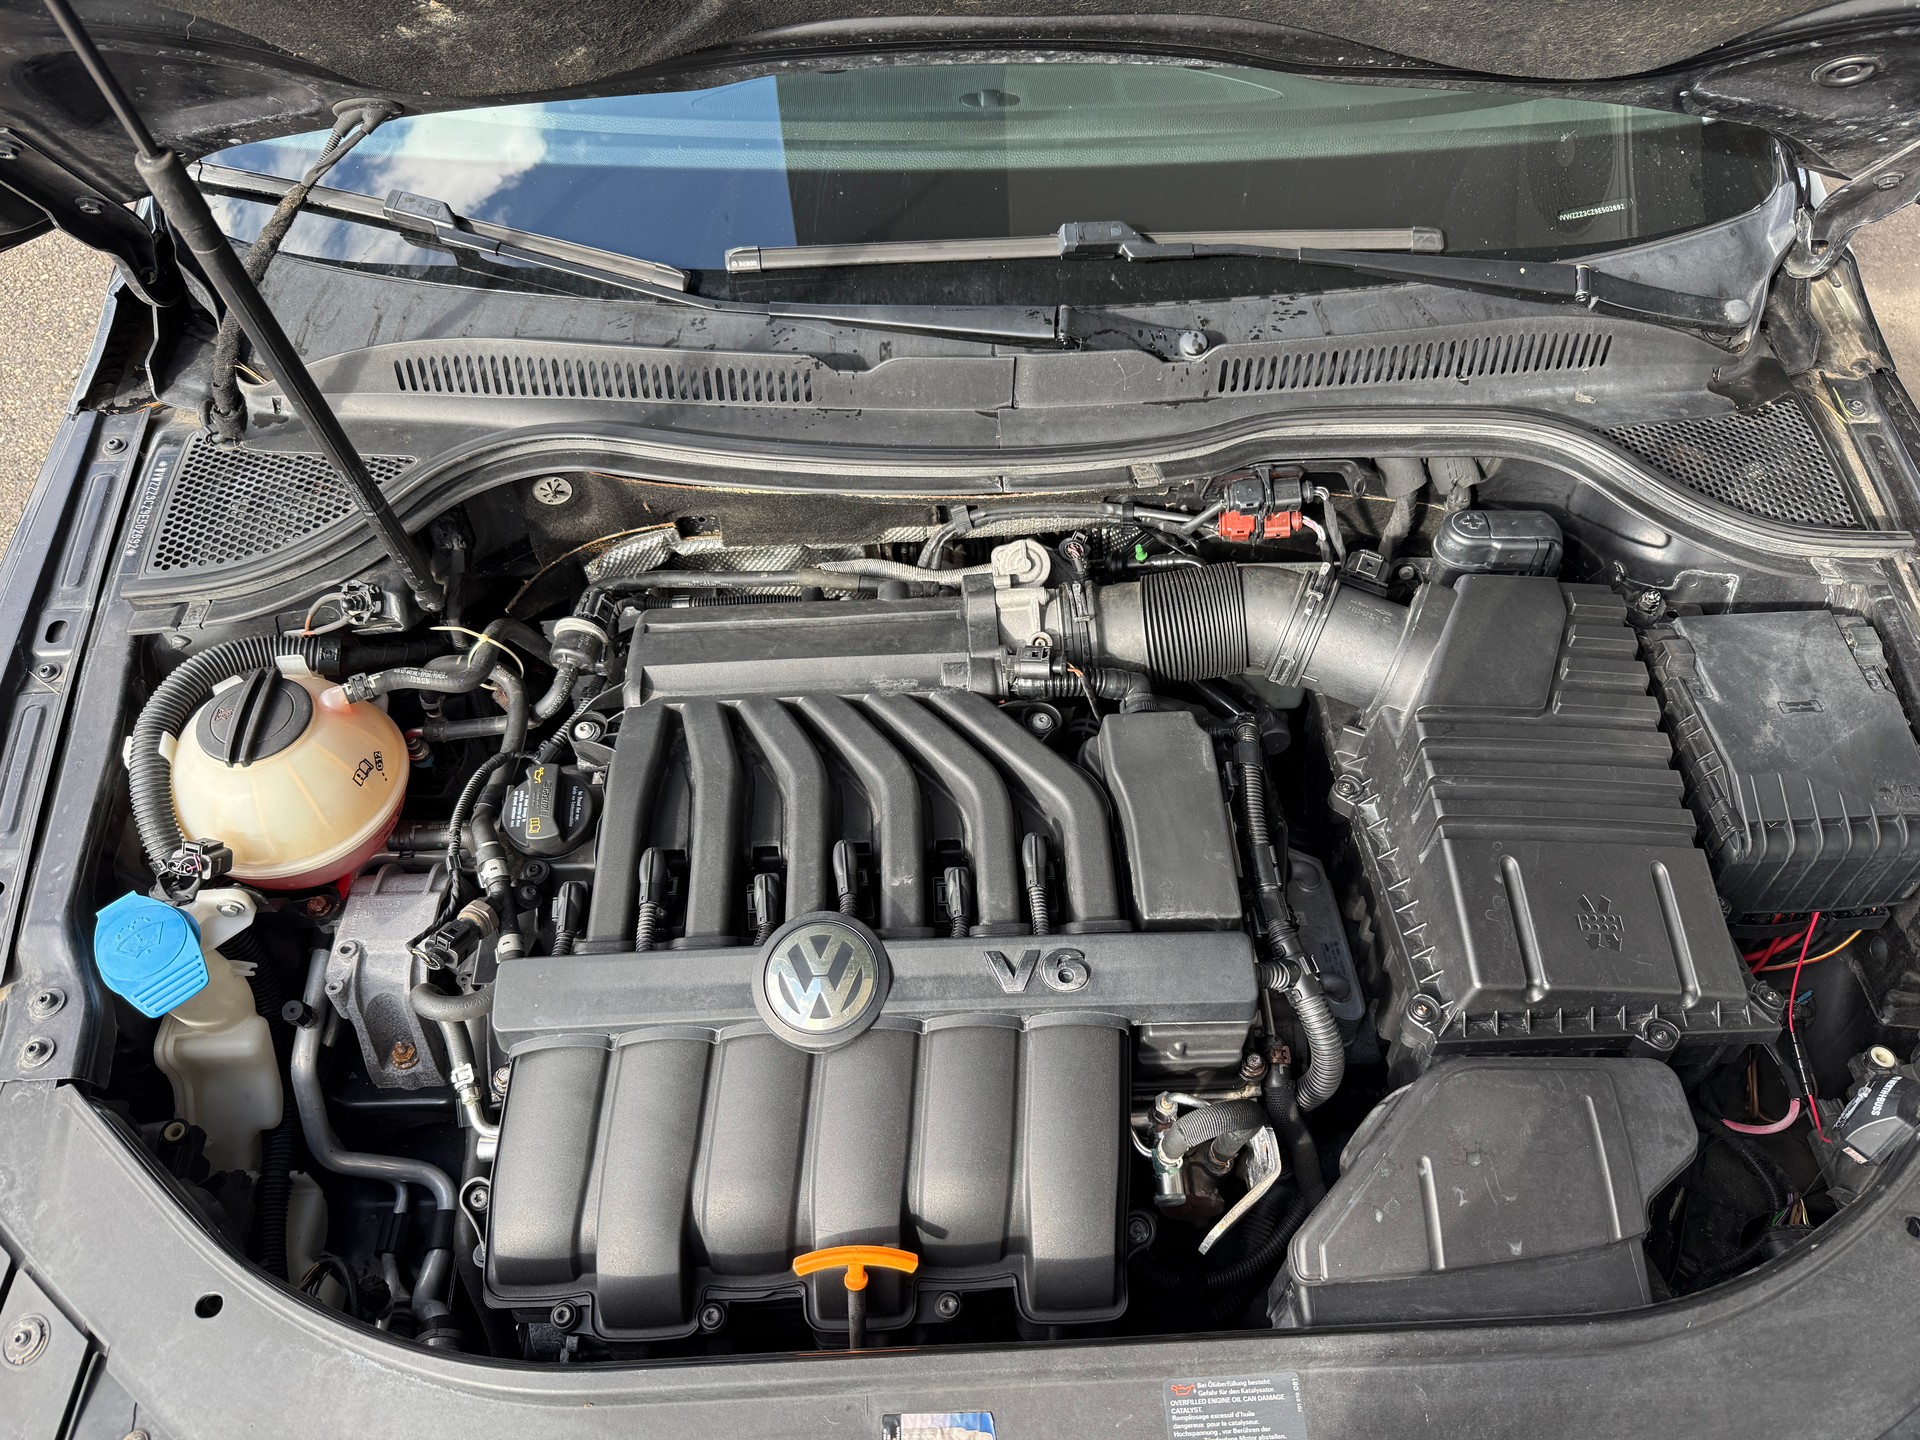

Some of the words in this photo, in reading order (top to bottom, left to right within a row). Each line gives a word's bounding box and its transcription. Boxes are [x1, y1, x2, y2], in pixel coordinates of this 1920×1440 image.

[374, 751, 383, 771] G12
[983, 948, 1092, 994] V6
[1198, 1389, 1218, 1397] Gefahr
[1170, 1399, 1207, 1407] OVERFILLED
[1172, 1414, 1210, 1422] Remplissage
[1210, 1411, 1235, 1419] excessif
[1173, 1422, 1205, 1430] dangereux
[1233, 1426, 1261, 1434] Berühren
